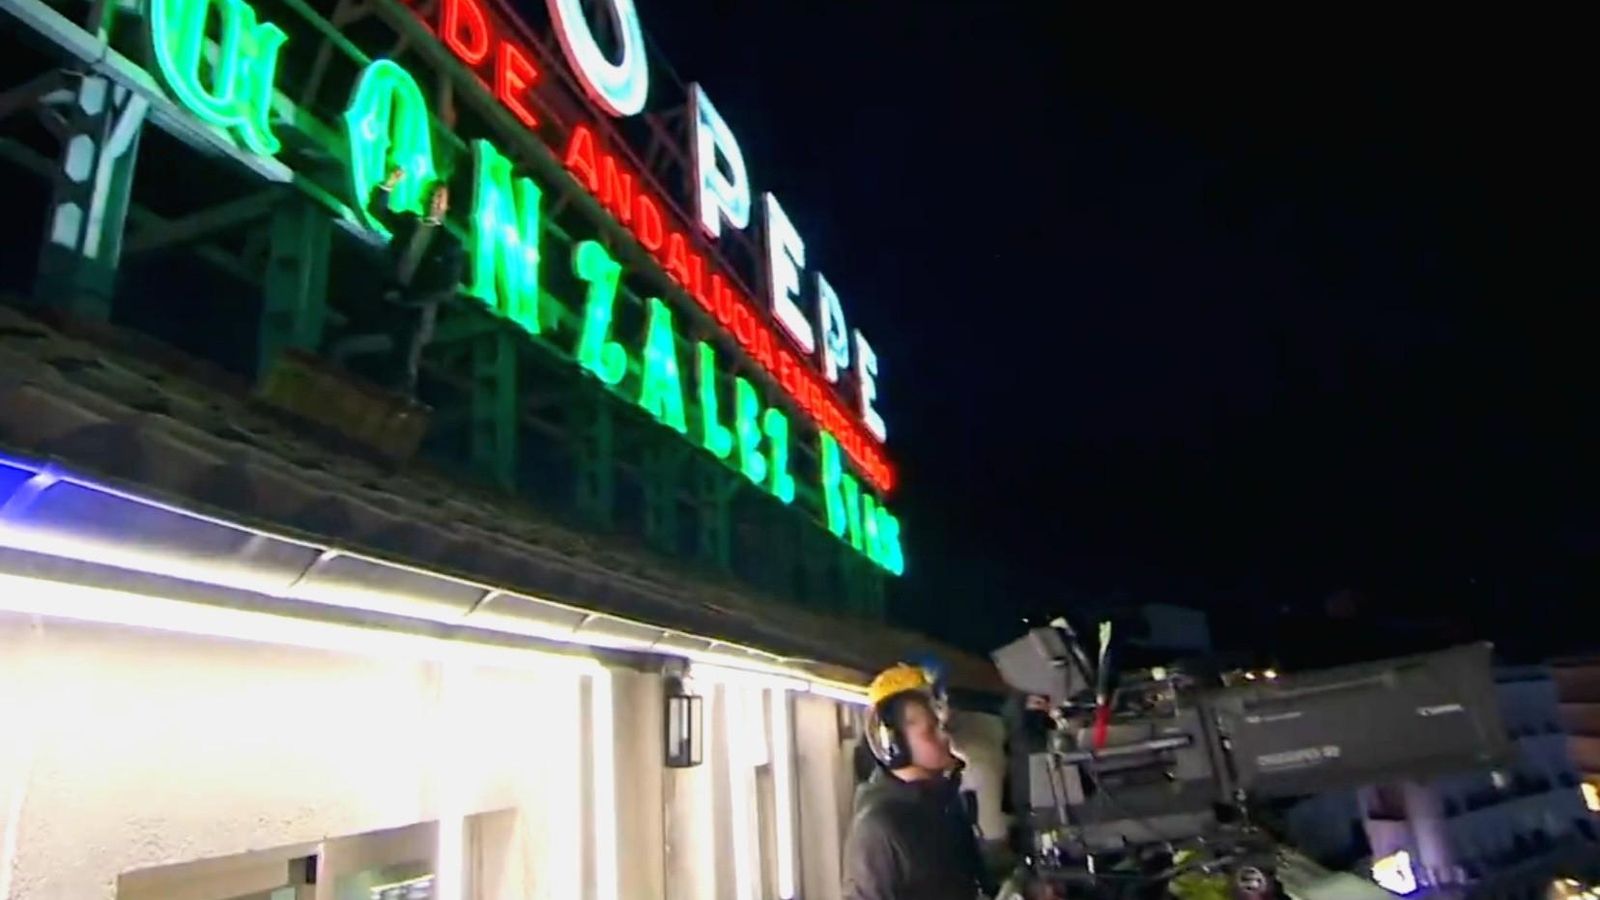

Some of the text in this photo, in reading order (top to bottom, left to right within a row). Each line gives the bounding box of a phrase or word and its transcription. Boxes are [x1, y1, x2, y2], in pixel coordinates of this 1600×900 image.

[444, 0, 538, 127] DE
[566, 125, 776, 370] ANDALUCIA
[690, 81, 886, 443] PEPE
